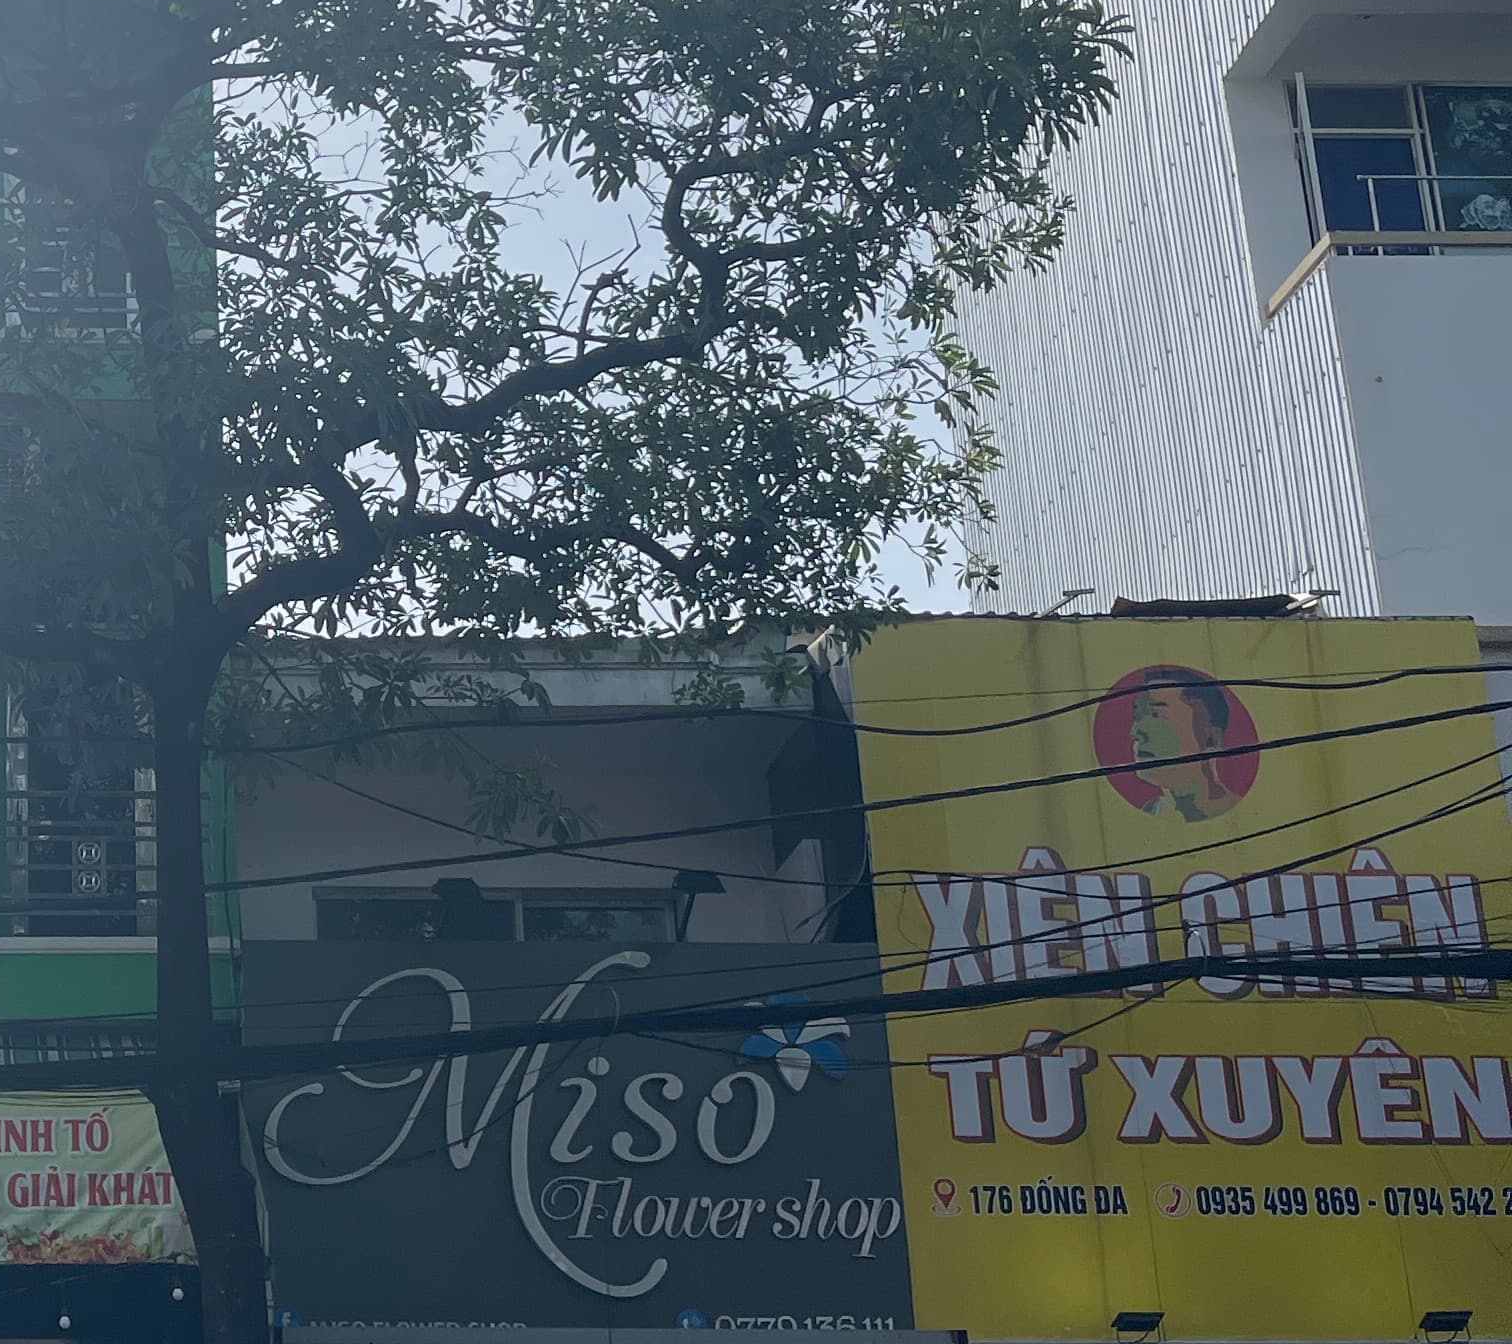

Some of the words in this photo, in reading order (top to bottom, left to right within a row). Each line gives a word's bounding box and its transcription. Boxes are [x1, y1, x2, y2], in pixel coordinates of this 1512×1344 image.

[913, 846, 1162, 997] XIÊN
[1179, 847, 1499, 999] CHIÊN
[928, 1030, 1097, 1143] TỨ
[1109, 1037, 1512, 1144] XUYÊN
[61, 1106, 111, 1154] TỐ
[264, 951, 776, 1297] Miso
[6, 1163, 79, 1209] GIẢI
[86, 1163, 174, 1207] KHÁT
[540, 1175, 766, 1242] Flower
[772, 1178, 900, 1258] shop
[968, 1184, 1013, 1215] 176
[1019, 1175, 1088, 1215] ĐỐNG
[1094, 1184, 1129, 1215] ĐA
[1196, 1186, 1256, 1216] 0935
[1263, 1186, 1308, 1216] 499
[1315, 1186, 1360, 1216] 869
[1383, 1186, 1444, 1216] 0794
[1449, 1186, 1497, 1217] 542
